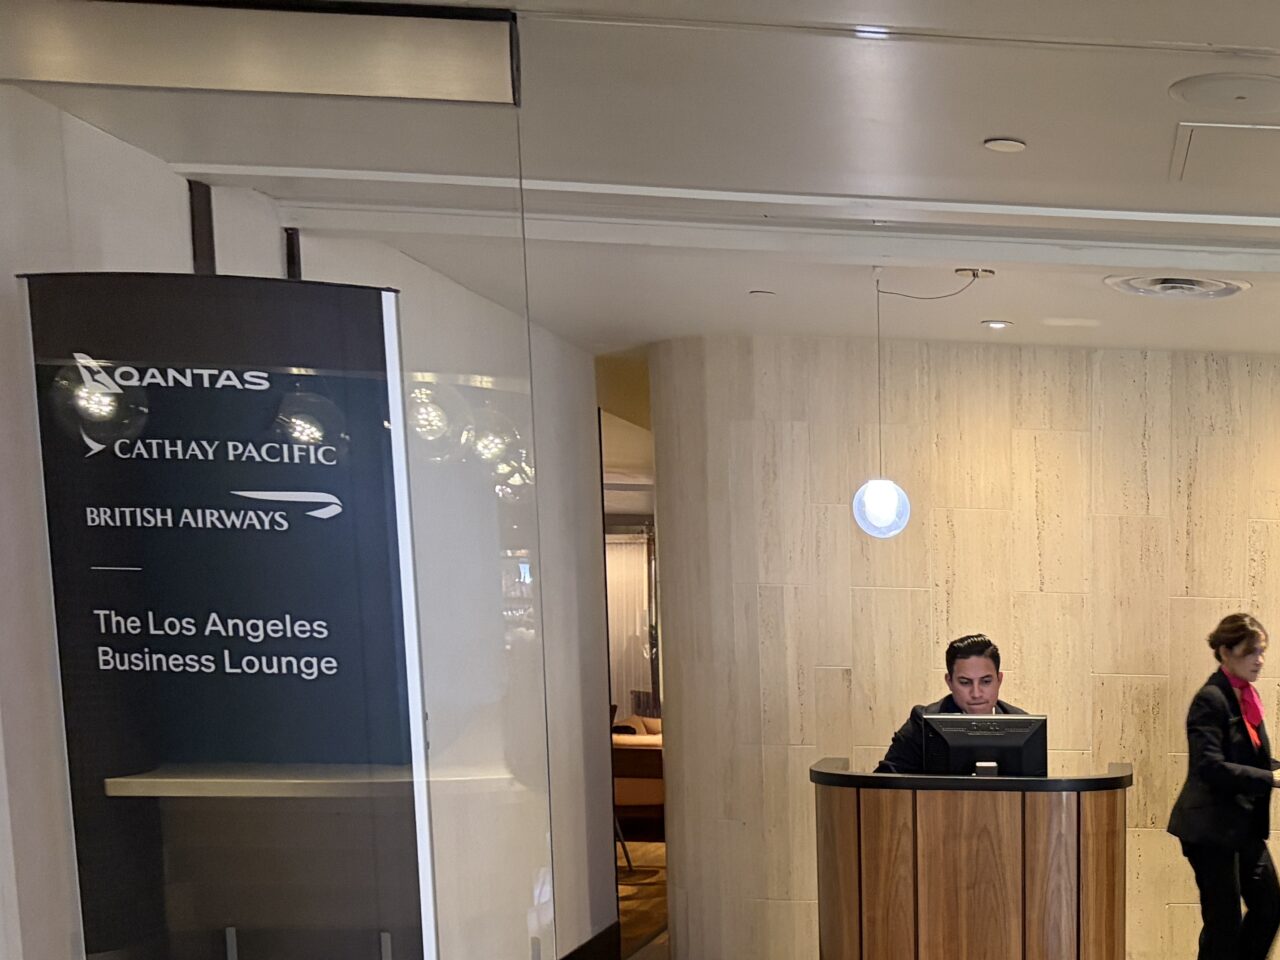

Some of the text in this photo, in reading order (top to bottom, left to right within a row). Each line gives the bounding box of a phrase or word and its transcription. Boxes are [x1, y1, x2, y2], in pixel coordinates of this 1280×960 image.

[113, 366, 271, 391] QANTAS
[114, 439, 337, 465] CATHAY PACIFIC
[86, 507, 289, 531] BRITISH AIRWAYS
[93, 609, 329, 642] The Los Angeles
[97, 646, 338, 680] Business Lounge
